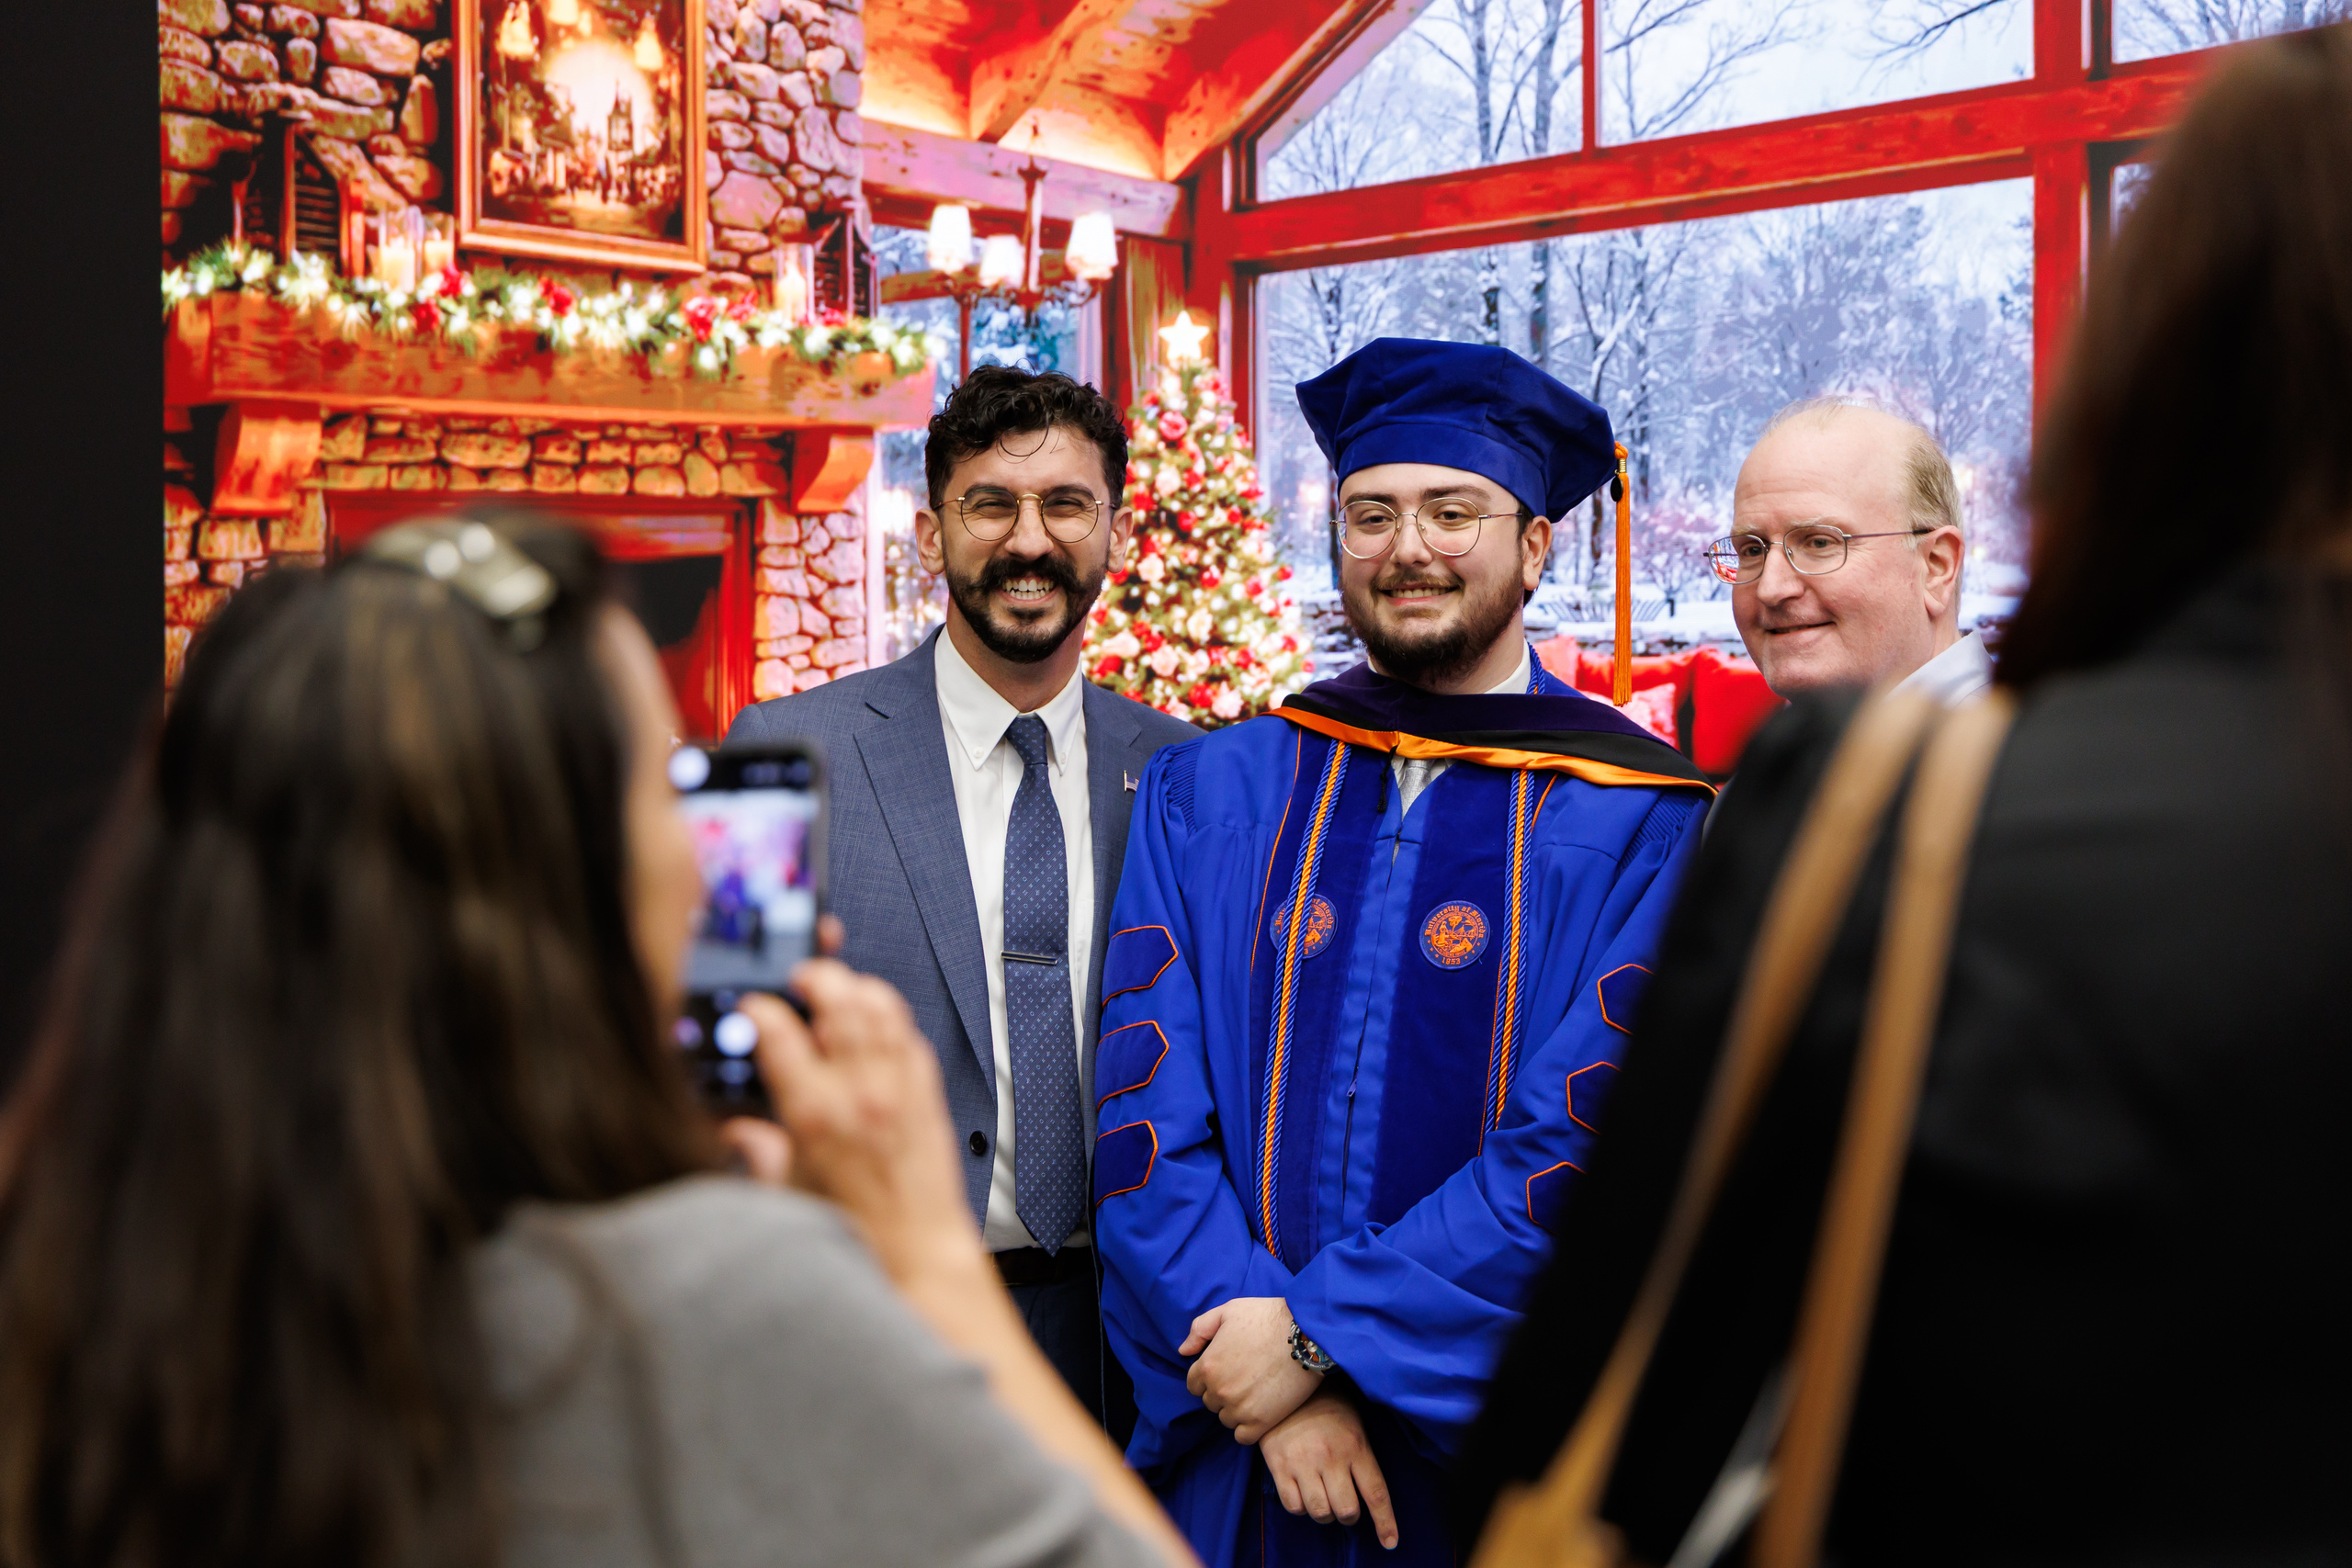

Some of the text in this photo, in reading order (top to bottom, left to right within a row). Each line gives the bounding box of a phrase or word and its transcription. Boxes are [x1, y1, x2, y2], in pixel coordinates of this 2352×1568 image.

[1318, 902, 1334, 930] Florida
[1424, 905, 1460, 937] University
[1469, 909, 1487, 939] Florida
[1442, 957, 1461, 965] 1853
